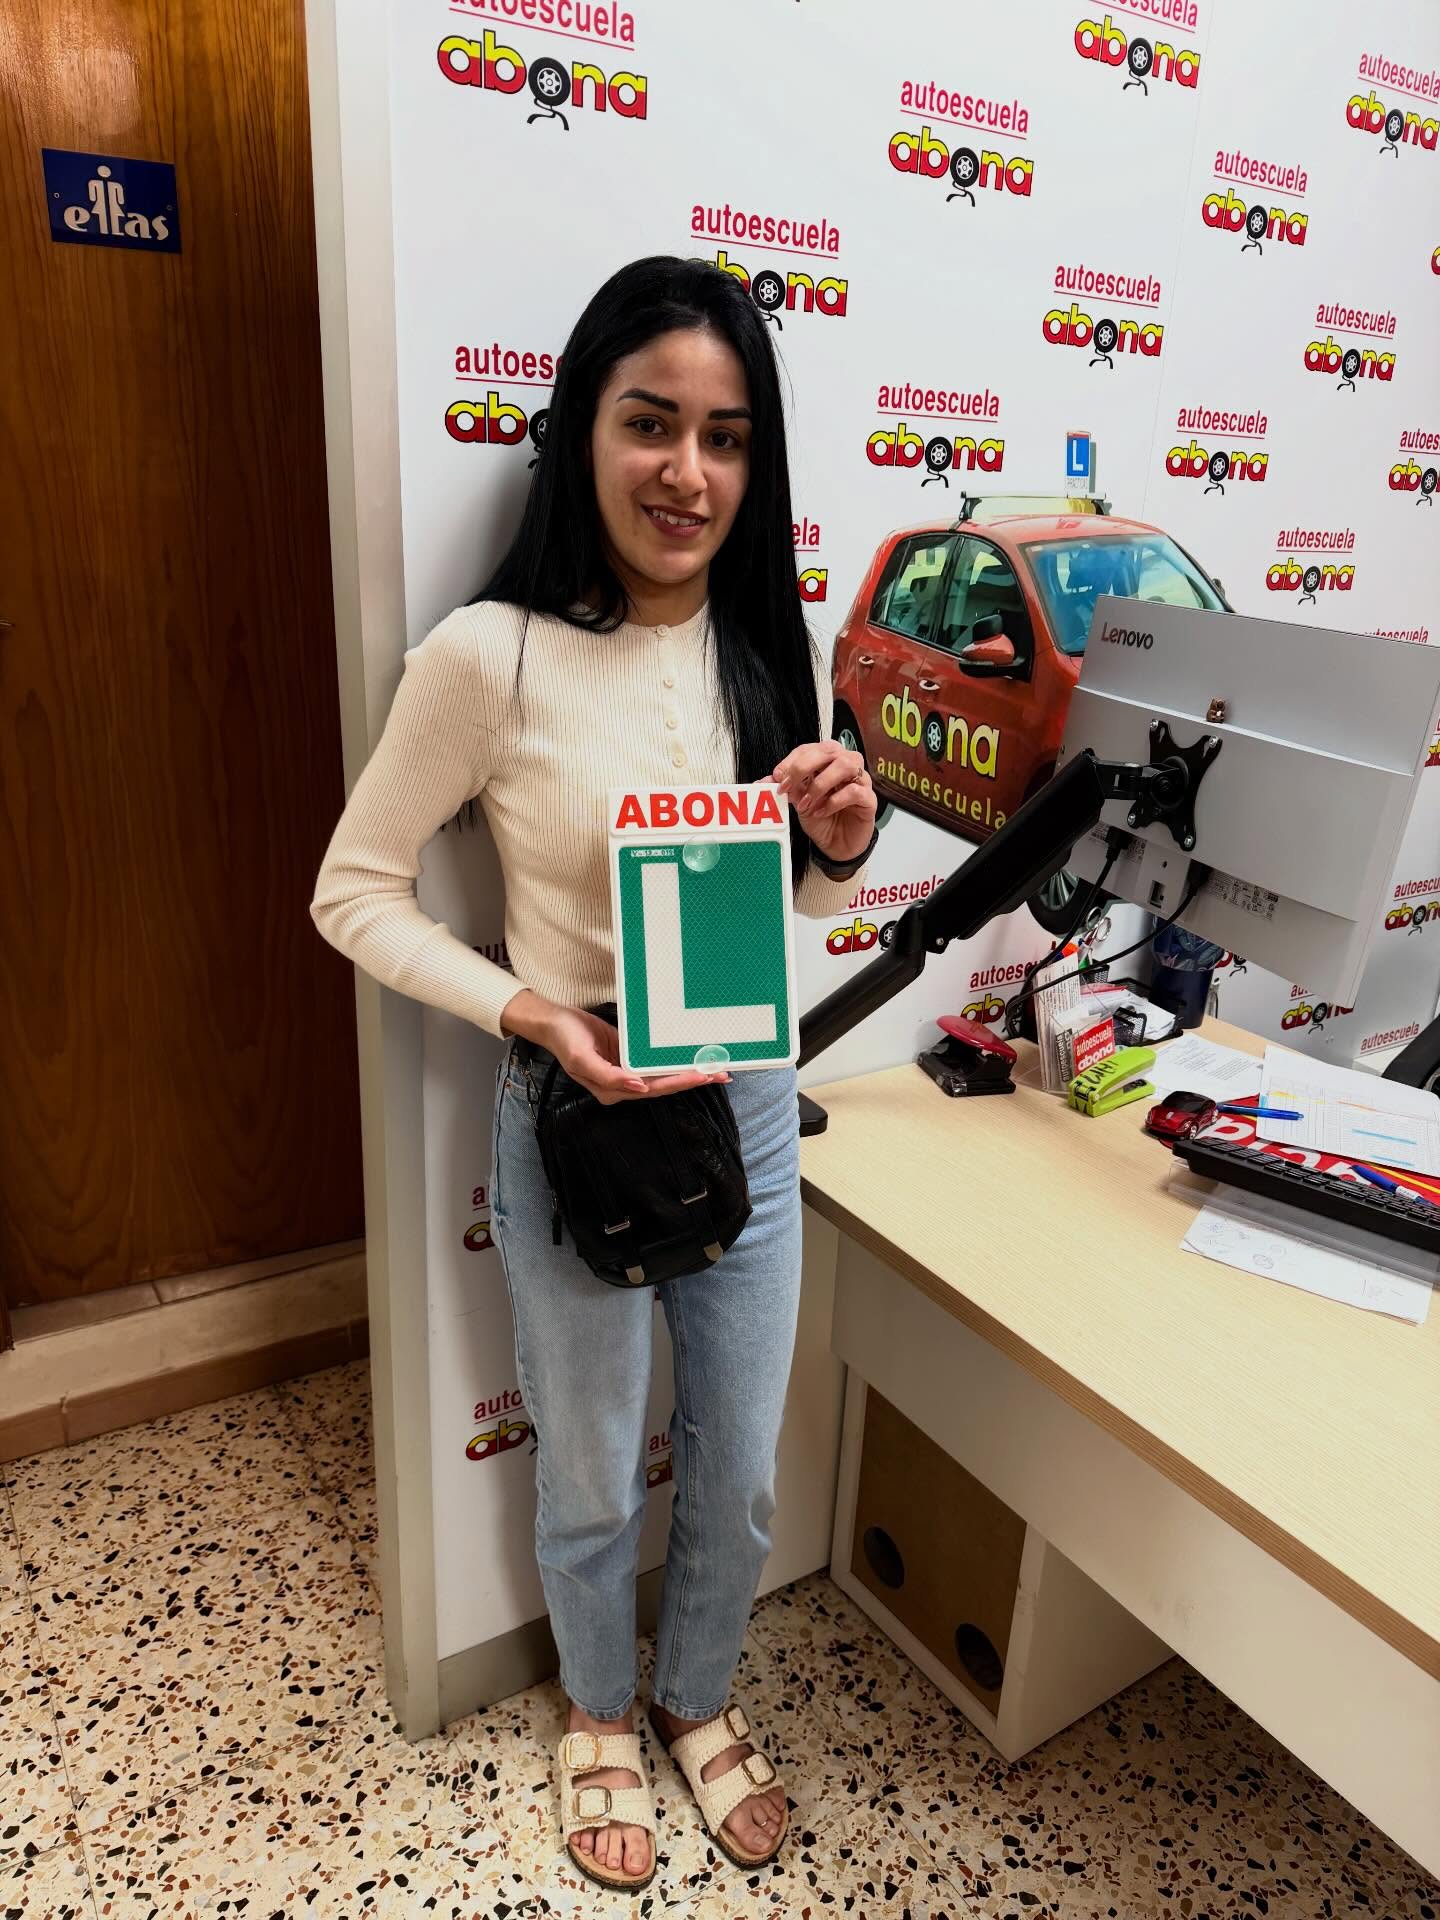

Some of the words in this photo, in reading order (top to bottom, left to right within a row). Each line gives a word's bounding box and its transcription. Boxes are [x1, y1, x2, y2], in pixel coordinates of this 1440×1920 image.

[451, 0, 635, 42] oescuela
[1074, 14, 1200, 88] abona
[437, 29, 648, 120] abona
[900, 80, 1029, 134] autoescuela
[1345, 90, 1440, 151] abona
[888, 126, 1034, 196] abona
[1214, 149, 1308, 193] autoescuela
[691, 203, 840, 253] autoescuela
[1202, 189, 1308, 246] abona
[690, 250, 848, 317] bona
[1054, 264, 1161, 303] autoescuela
[1042, 303, 1164, 358] abona
[1316, 303, 1397, 335] autoescuela
[1304, 336, 1396, 382] abona
[877, 382, 1000, 417] autoescuela
[1177, 405, 1268, 435] autoescuela
[866, 423, 1005, 473] abona
[1072, 440, 1084, 471] L
[1166, 440, 1269, 483] abona
[1277, 527, 1355, 550] autoescuela
[1266, 558, 1355, 592] abona
[1101, 622, 1154, 650] Lenovo
[881, 685, 1001, 778] abona
[615, 790, 784, 829] ABONA
[877, 756, 1006, 830] autoescuela
[641, 862, 778, 1048] L
[1360, 1022, 1420, 1050] autoescuela
